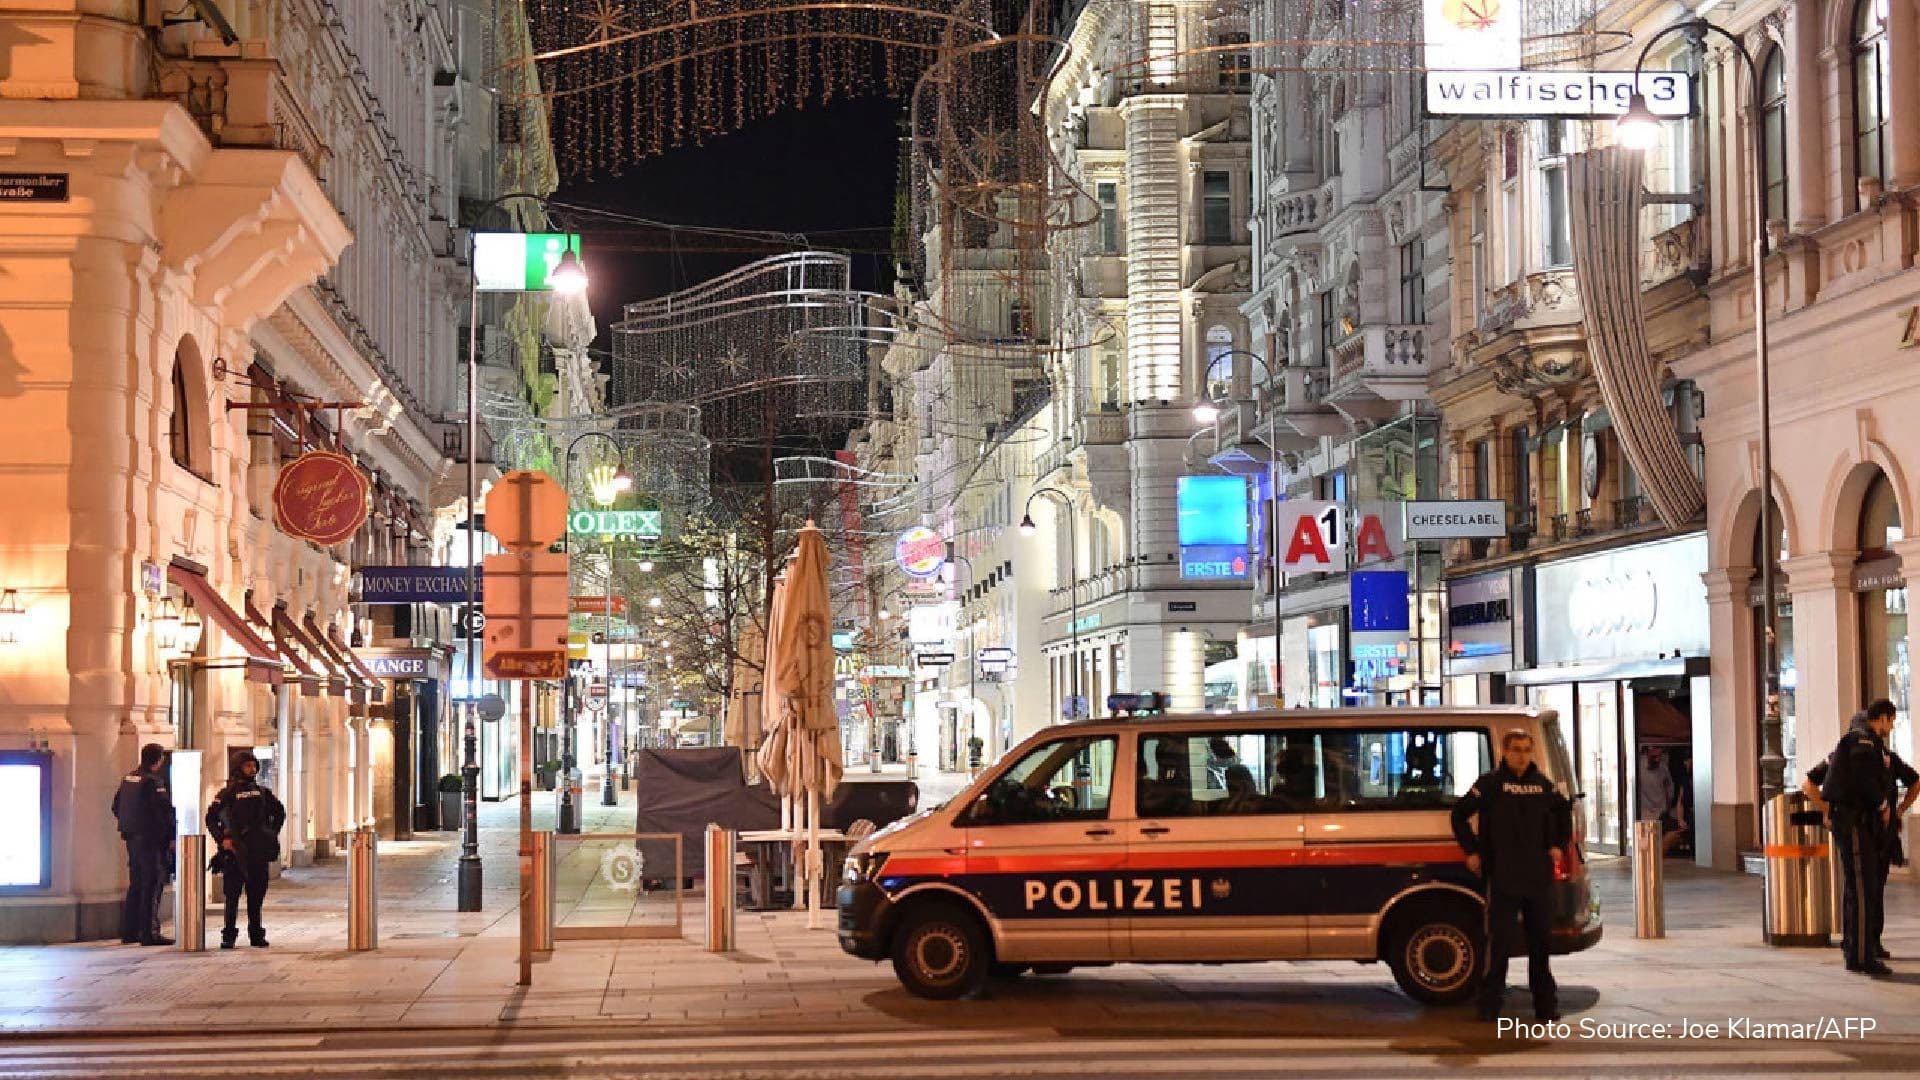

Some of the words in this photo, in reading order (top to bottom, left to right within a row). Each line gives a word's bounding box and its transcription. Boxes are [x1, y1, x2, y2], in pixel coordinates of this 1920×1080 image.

[1653, 76, 1675, 101] 3
[0, 176, 64, 186] armoniker-
[1412, 514, 1500, 526] CHEESELABEL
[1285, 508, 1338, 563] A1
[1185, 561, 1232, 576] ERSTE
[365, 576, 410, 592] MONEY
[1502, 782, 1543, 795] POLIZEI
[1024, 878, 1201, 911] POLIZEI
